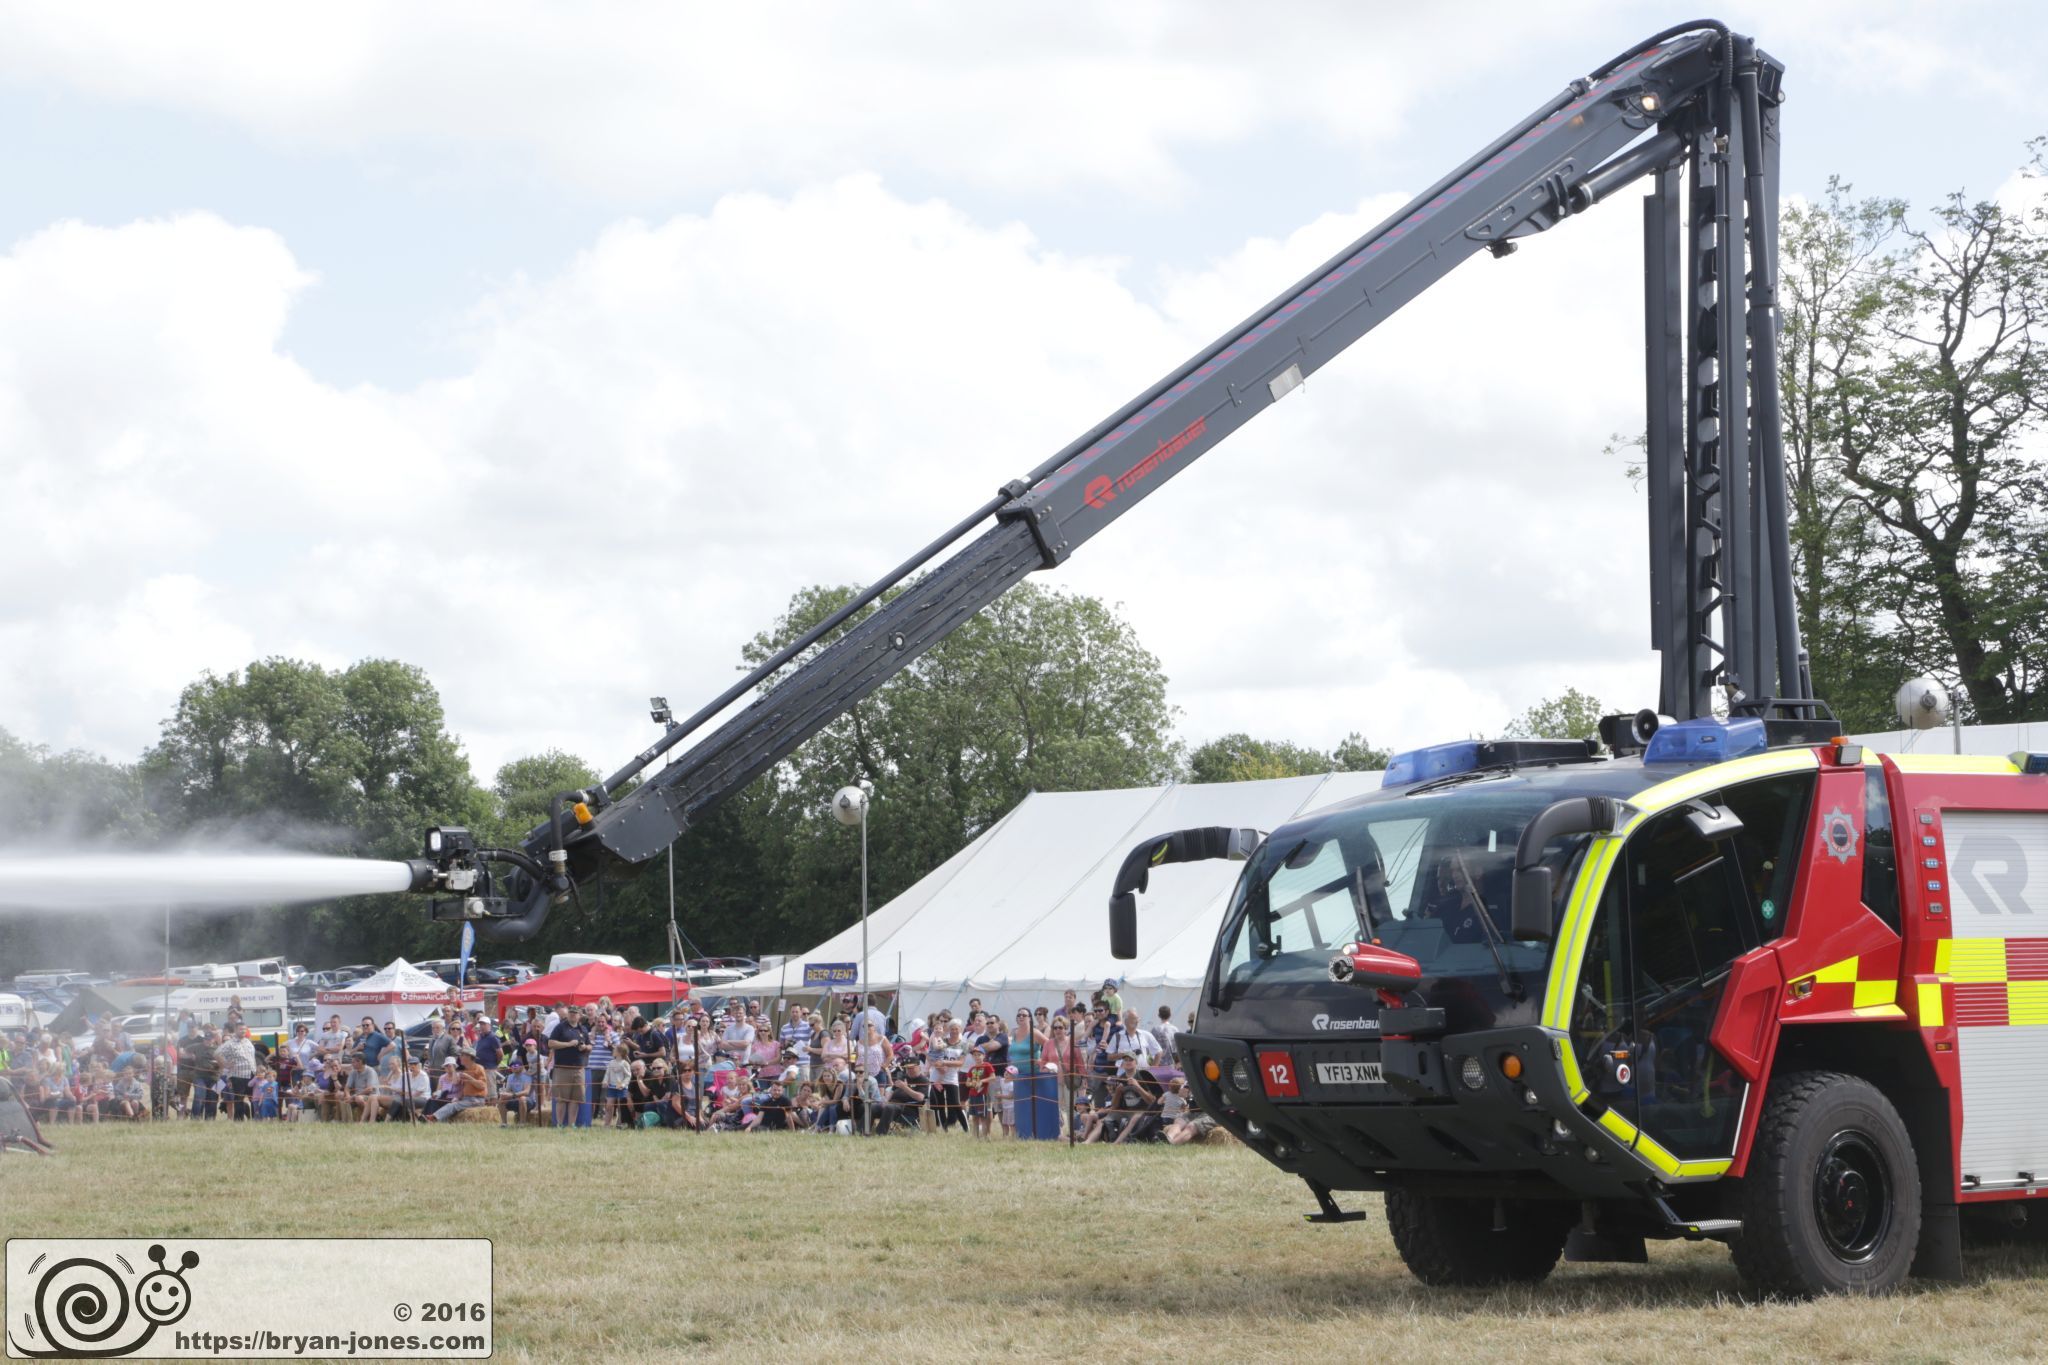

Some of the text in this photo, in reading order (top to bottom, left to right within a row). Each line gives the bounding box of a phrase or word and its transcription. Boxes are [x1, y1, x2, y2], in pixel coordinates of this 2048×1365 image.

[1116, 415, 1208, 493] rosenbauer
[807, 968, 855, 981] BEER TENT
[1330, 1016, 1380, 1030] rosenbau
[1269, 1064, 1289, 1084] 12
[1324, 1066, 1380, 1081] YF13 XNM
